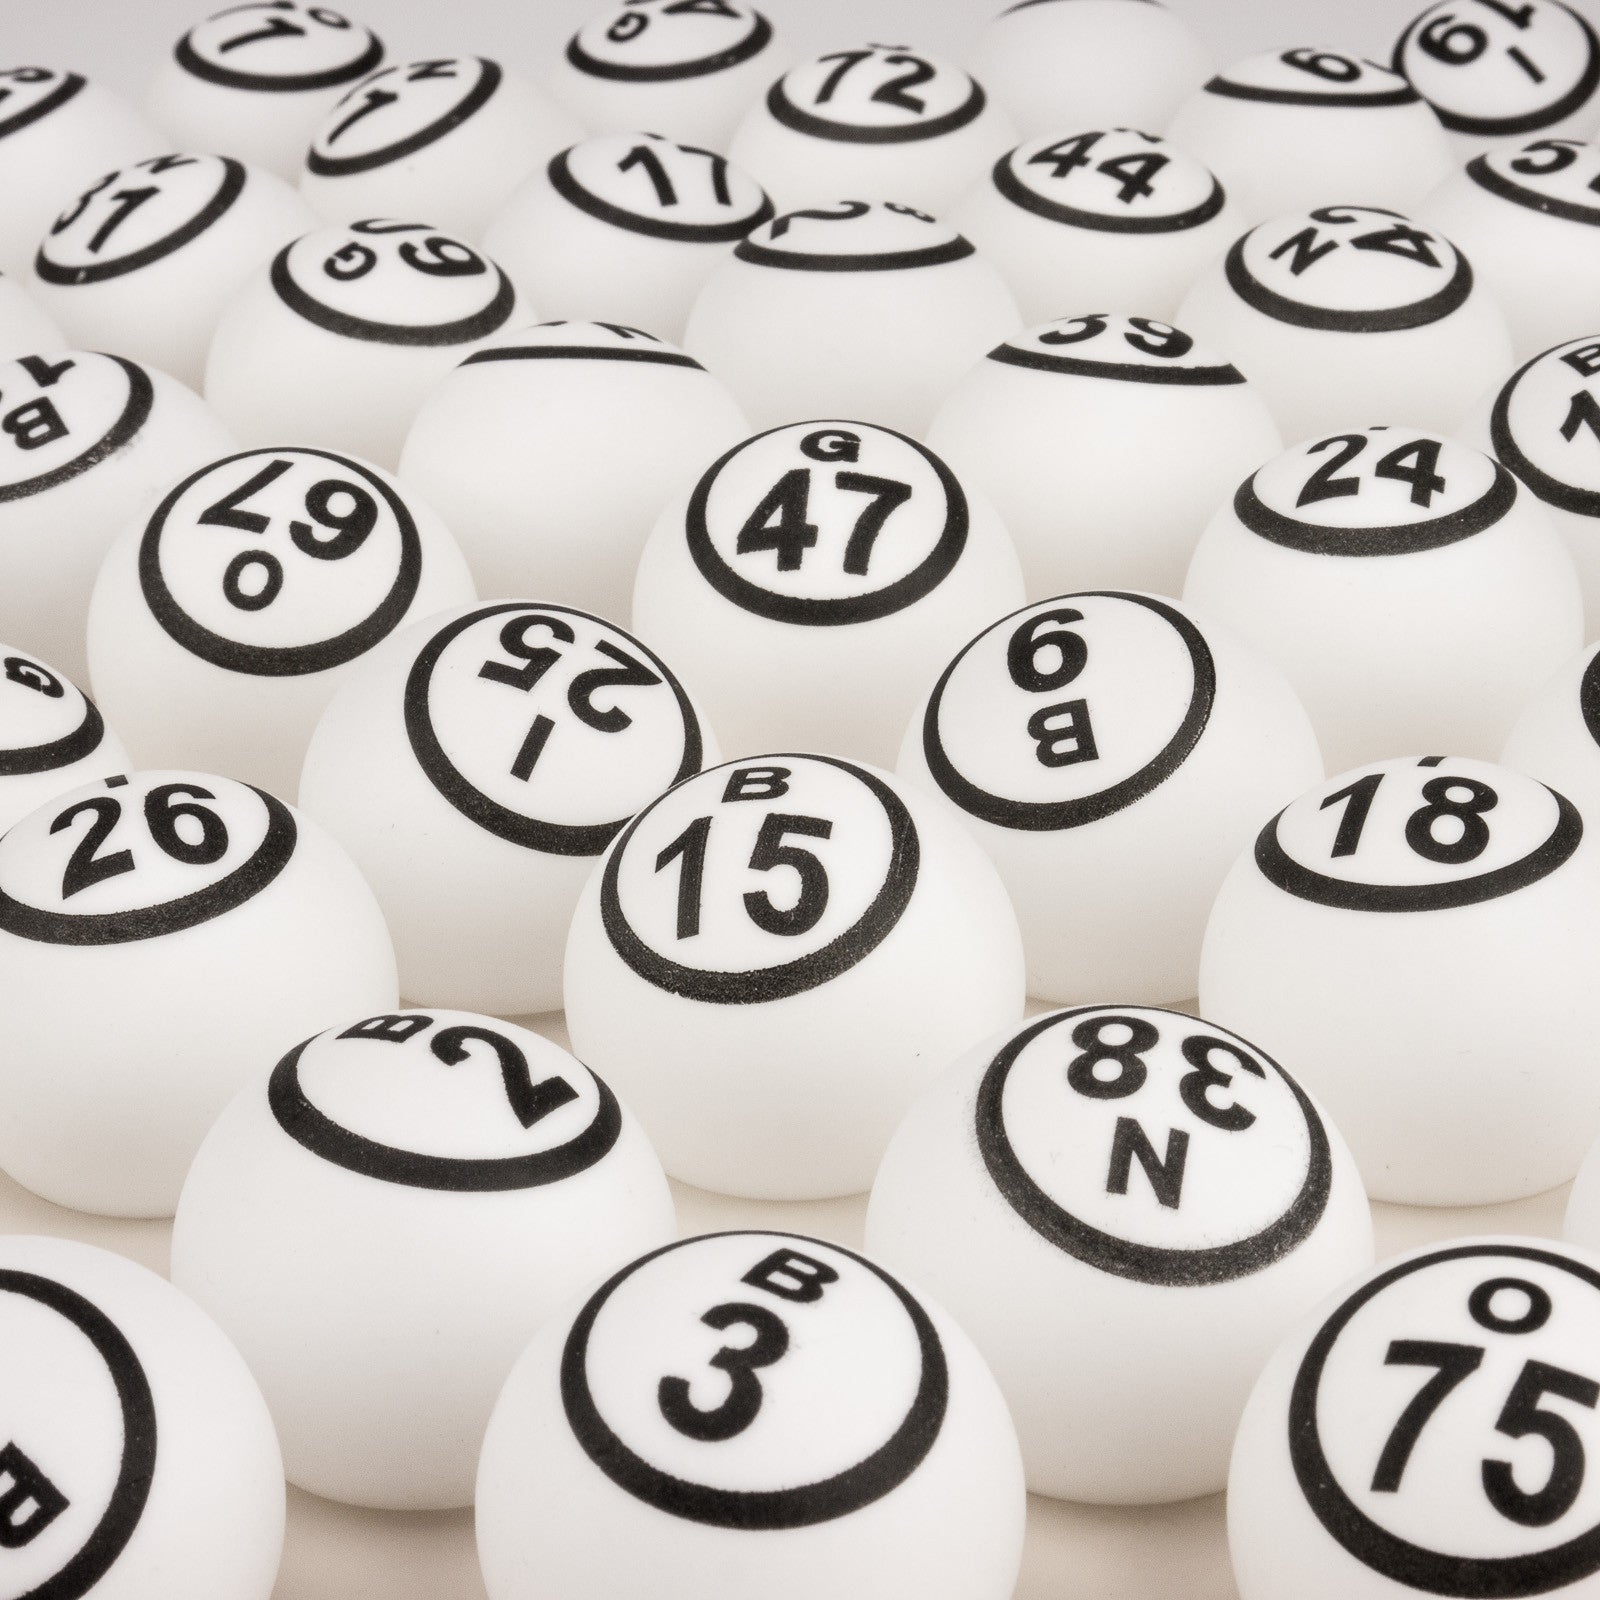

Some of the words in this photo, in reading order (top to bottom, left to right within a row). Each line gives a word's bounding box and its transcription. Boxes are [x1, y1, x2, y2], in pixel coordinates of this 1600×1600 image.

[307, 8, 351, 30] O
[606, 11, 649, 43] G
[814, 50, 936, 115] 72
[617, 145, 732, 206] 17
[1026, 131, 1170, 204] 44
[323, 241, 377, 282] G
[1268, 227, 1340, 276] N
[2, 396, 70, 451] B
[799, 429, 862, 463] G
[1295, 434, 1446, 509] 24
[197, 459, 379, 561] 67
[736, 468, 912, 576] 47
[222, 549, 284, 612] O
[3, 656, 65, 699] G
[477, 614, 663, 734] 25
[509, 714, 556, 783] I
[1027, 698, 1100, 768] B
[721, 766, 792, 804] B
[1319, 773, 1499, 865] 18
[49, 783, 229, 901] 26
[654, 812, 834, 941] 15
[335, 1014, 434, 1044] B
[430, 1025, 580, 1130] 2
[1067, 1015, 1266, 1132] 38
[1106, 1116, 1190, 1210] N
[740, 1248, 840, 1304] B
[1467, 1277, 1552, 1335] O
[657, 1302, 790, 1443] 3
[1370, 1339, 1600, 1528] 75
